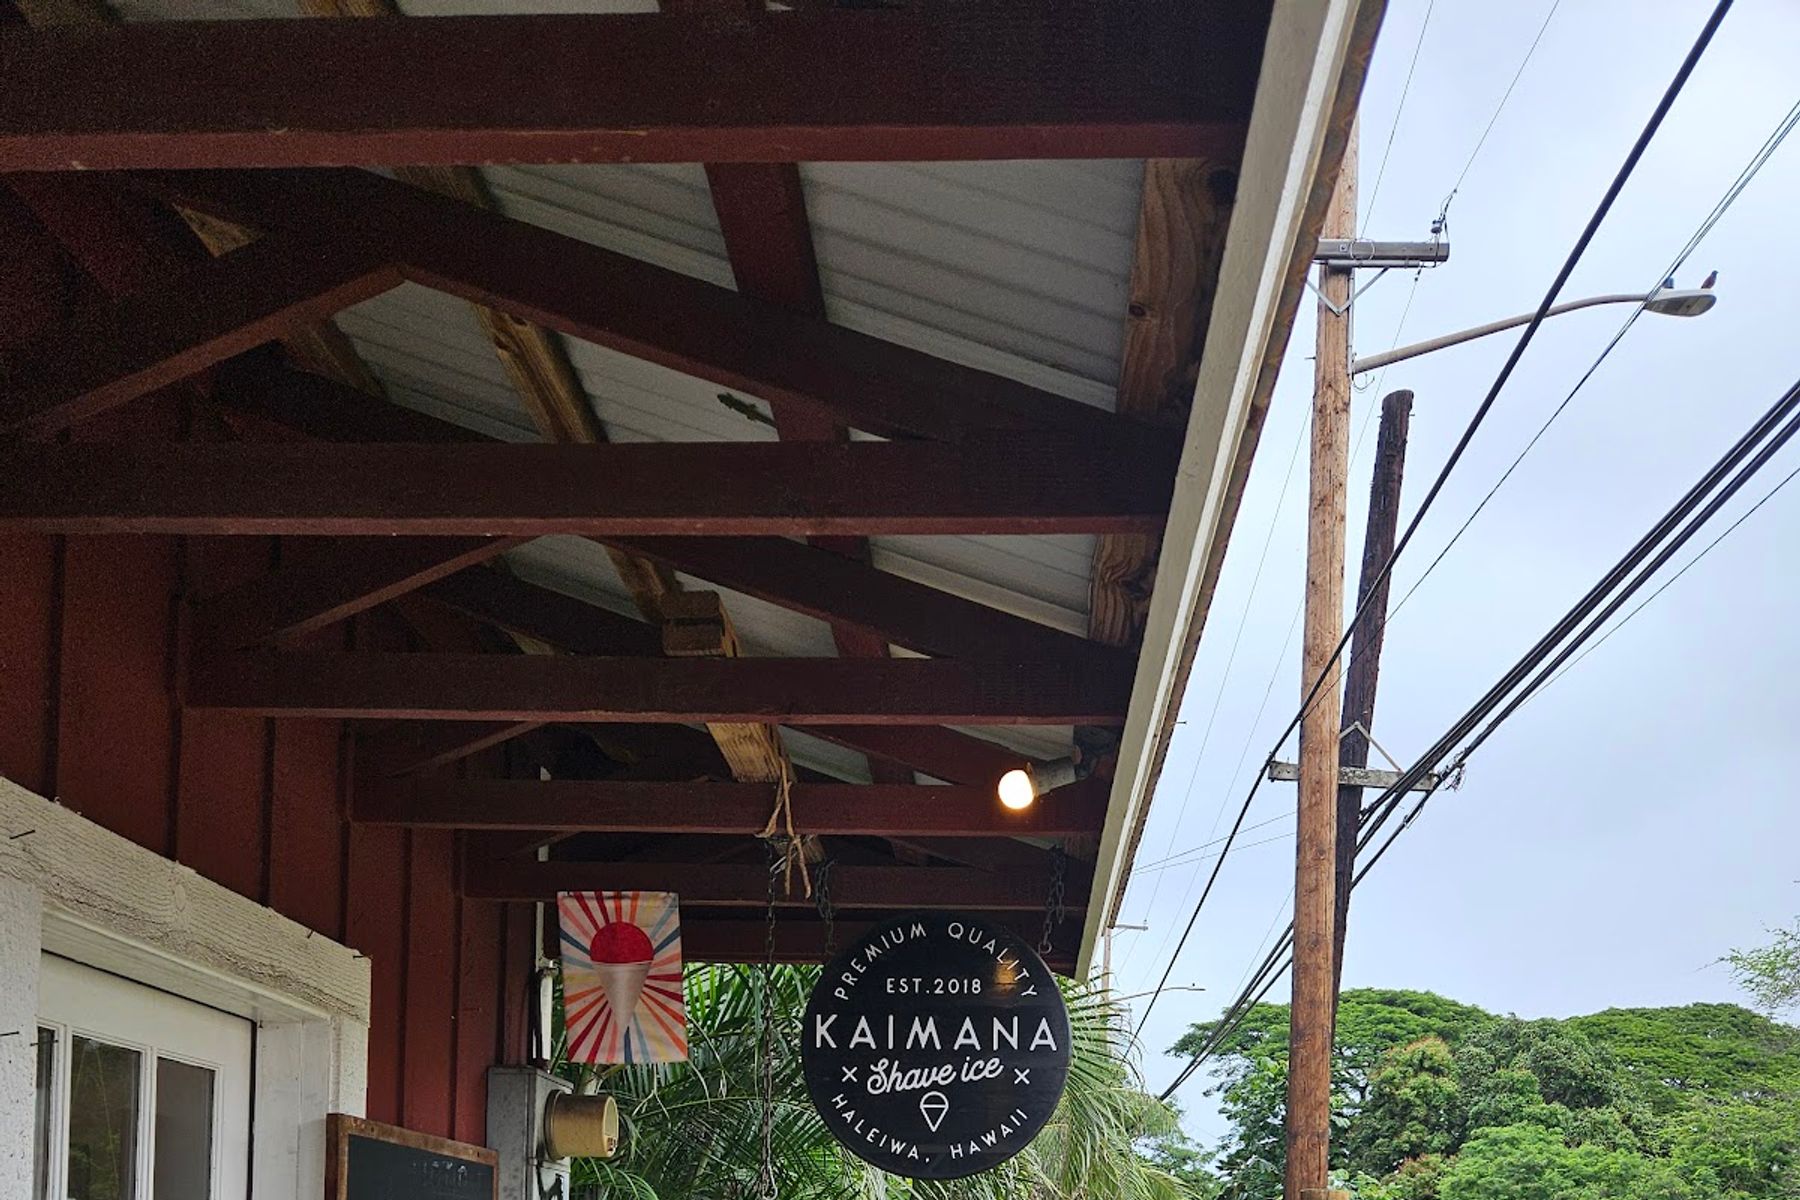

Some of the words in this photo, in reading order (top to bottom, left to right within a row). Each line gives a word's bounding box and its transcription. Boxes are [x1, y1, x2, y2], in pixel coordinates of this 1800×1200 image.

[835, 922, 927, 1000] PREMIUM
[948, 922, 1038, 997] QUALITY
[886, 978, 982, 995] EST.2018
[815, 1013, 1057, 1052] KAIMANA
[866, 1057, 957, 1095] Shave
[961, 1056, 1004, 1083] ice
[831, 1093, 931, 1164] HALEIWA,
[950, 1107, 1028, 1160] HAWAII
